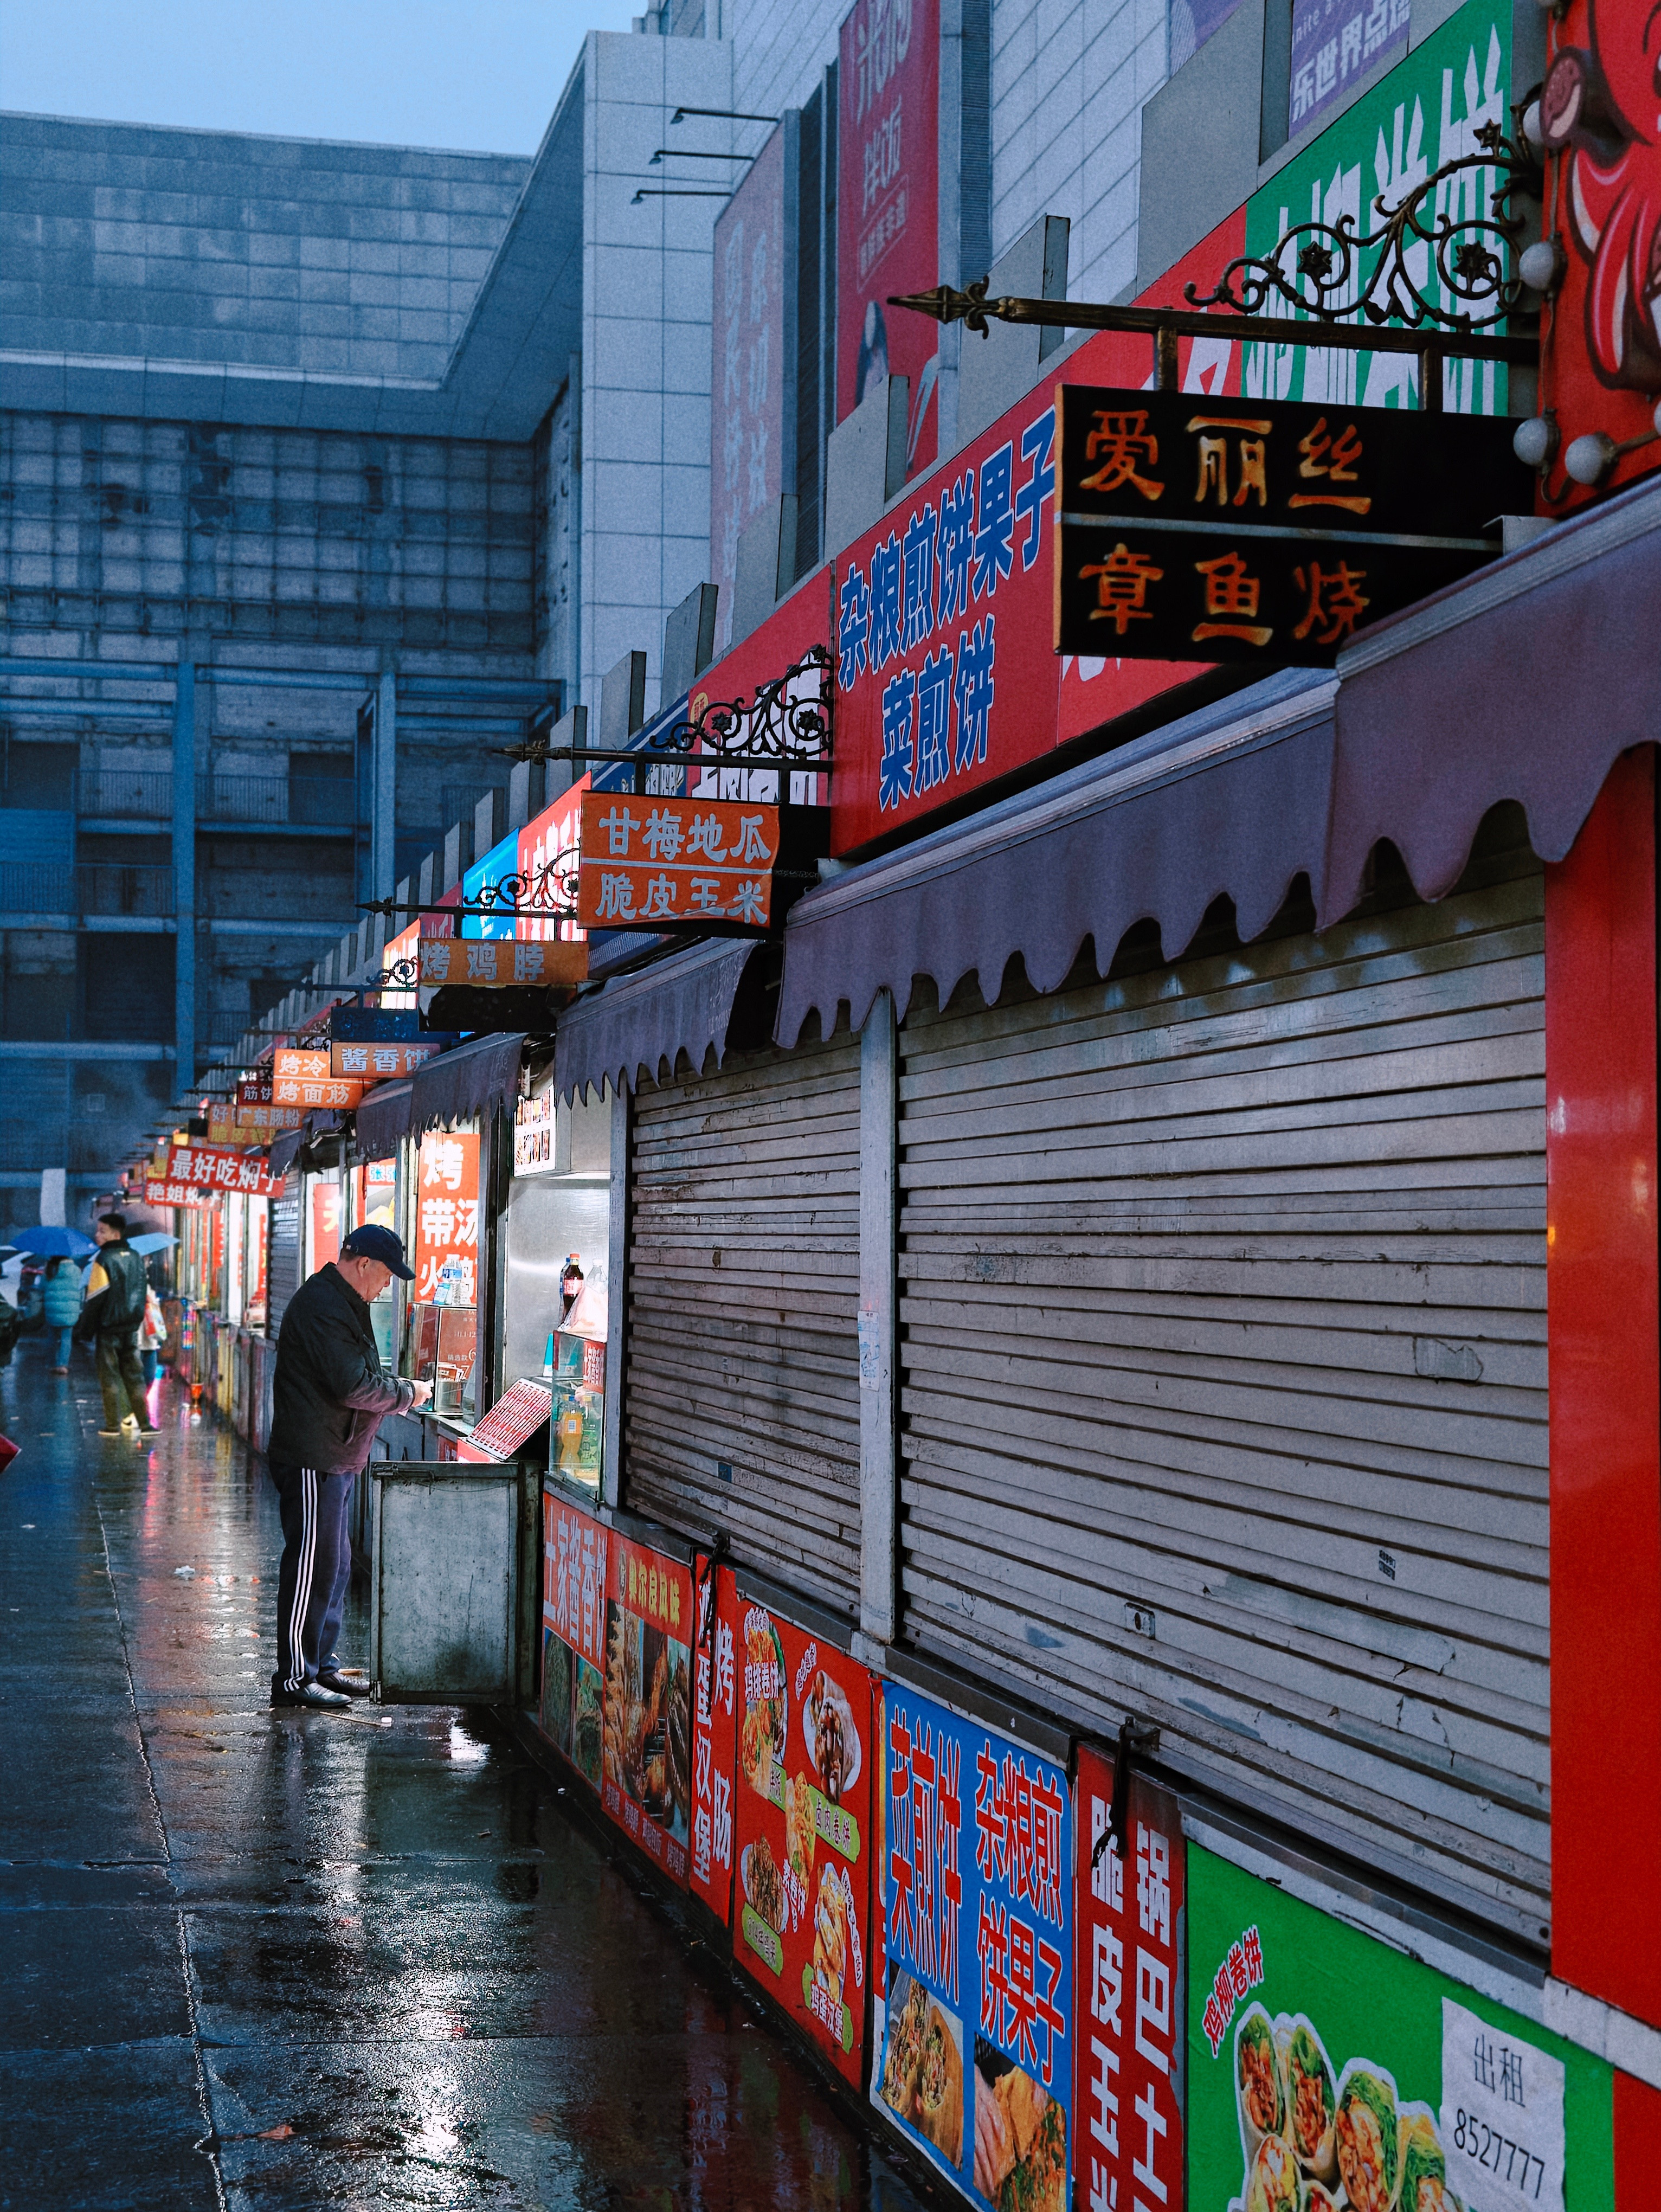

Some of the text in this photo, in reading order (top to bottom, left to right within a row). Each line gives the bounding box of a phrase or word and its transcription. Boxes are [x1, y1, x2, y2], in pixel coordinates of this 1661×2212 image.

[1079, 409, 1371, 515] 爱丽丝
[838, 404, 1055, 692] 杂粮煎饼果子
[1078, 543, 1370, 646] 章鱼烧
[879, 613, 995, 812] 菜煎饼
[598, 806, 772, 864] 甘梅地瓜
[595, 872, 768, 924] 脆皮玉米
[420, 942, 544, 982] 烤鸡脖
[277, 1081, 350, 1105] 烤面筋
[278, 1053, 331, 1078] 烤冷
[341, 1047, 430, 1073] 酱香饼
[211, 1105, 236, 1123] 好
[237, 1108, 300, 1127] 广东肠粉
[423, 1140, 464, 1191] 烤
[543, 1504, 608, 1667] 土家酱香饼
[629, 1554, 680, 1629] 奥尔良风味
[713, 1617, 735, 1870] 烤肠
[889, 1705, 962, 2005] 菜煎饼
[976, 1738, 1064, 1931] 杂粮煎
[810, 1983, 844, 2046] 鸡蛋汉堡
[976, 1888, 1066, 2086] 饼果子
[1133, 1819, 1170, 2212] 锅巴土
[1202, 1924, 1265, 2059] 鸡柳卷饼
[1473, 2033, 1526, 2108] 出租
[1454, 2108, 1546, 2198] 8527777
